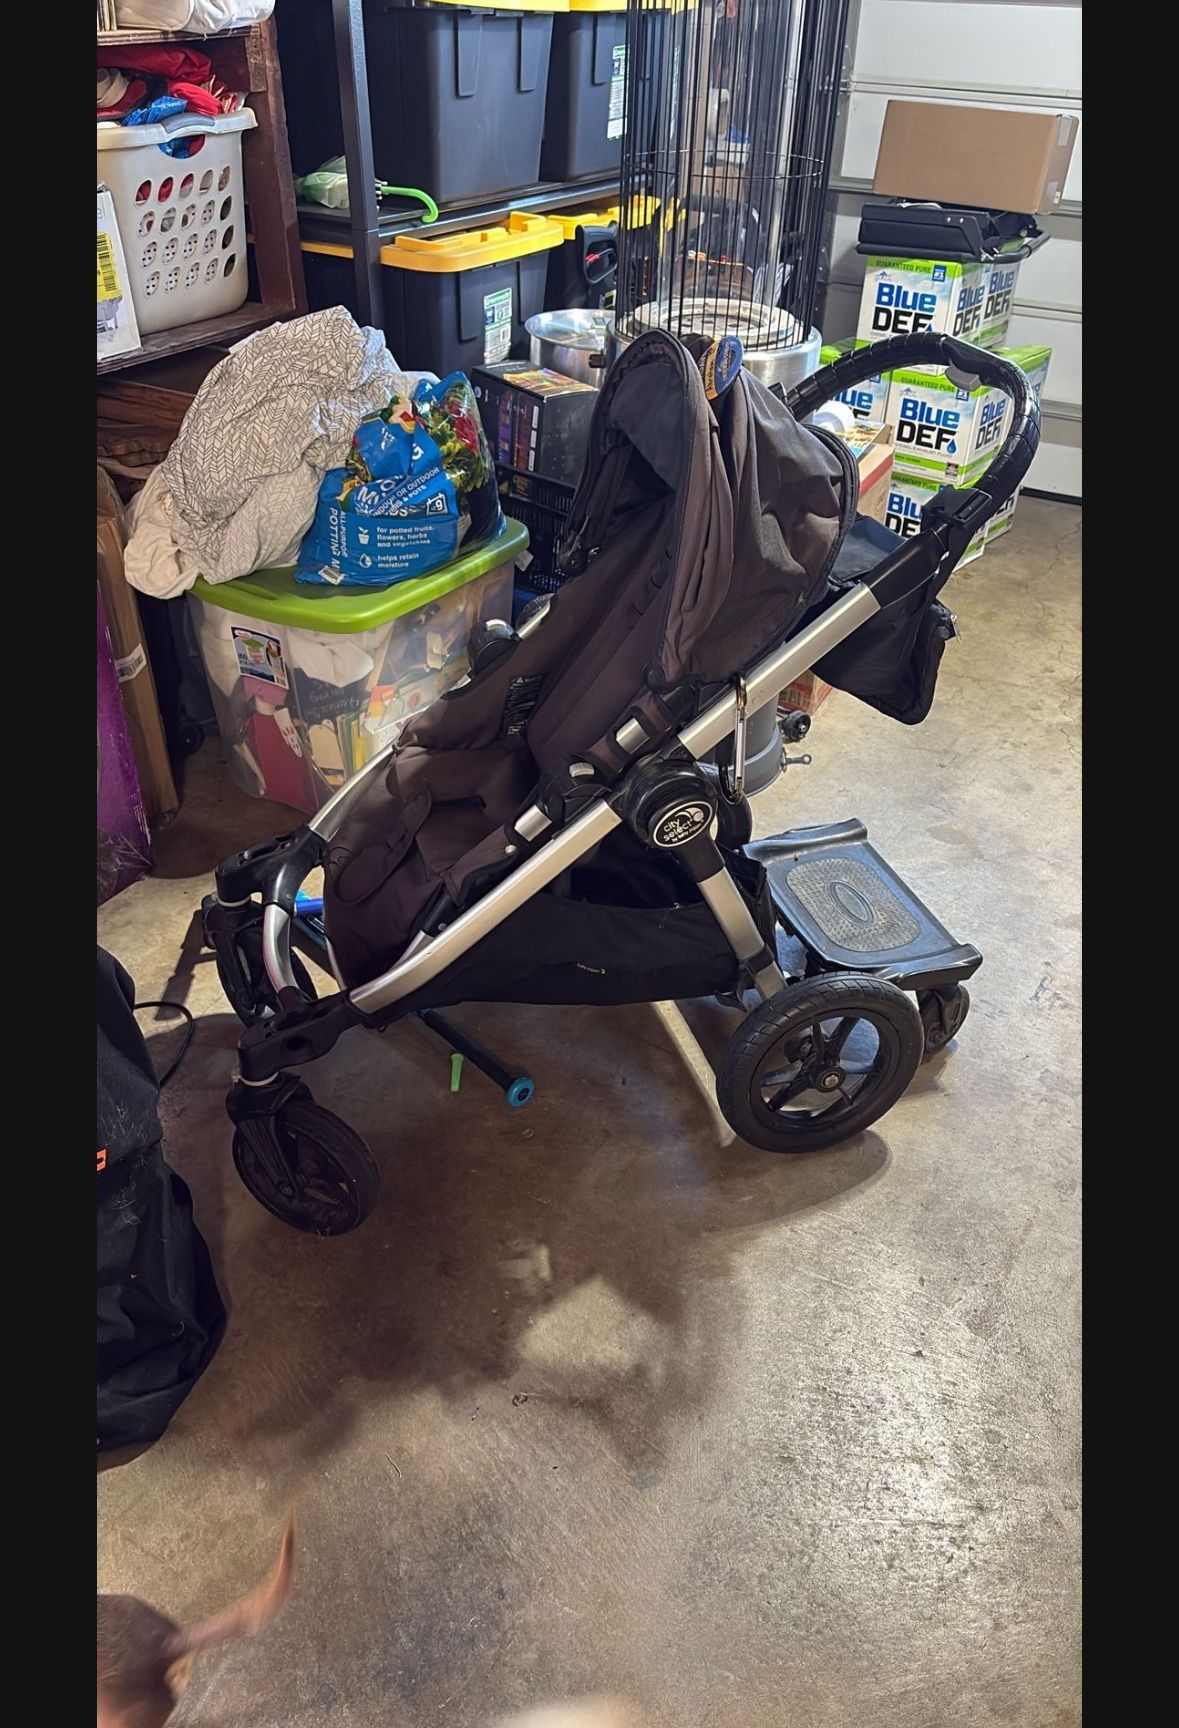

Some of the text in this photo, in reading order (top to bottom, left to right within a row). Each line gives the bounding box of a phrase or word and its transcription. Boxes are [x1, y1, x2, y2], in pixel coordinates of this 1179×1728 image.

[989, 271, 1015, 294] Blue
[876, 282, 937, 313] Blue
[957, 285, 985, 312] Blue
[984, 289, 1012, 319] DEF
[872, 306, 934, 334] DEF
[953, 304, 982, 337] DEF
[900, 398, 961, 429] Blue
[980, 399, 1006, 425] Blue
[896, 419, 957, 450] DEF
[975, 417, 1002, 450] DEF
[407, 467, 440, 490] OUTDOOR
[329, 507, 340, 557] POTTING
[389, 526, 412, 534] potted
[885, 513, 921, 539] DE
[663, 821, 692, 841] select
[664, 819, 680, 832] city
